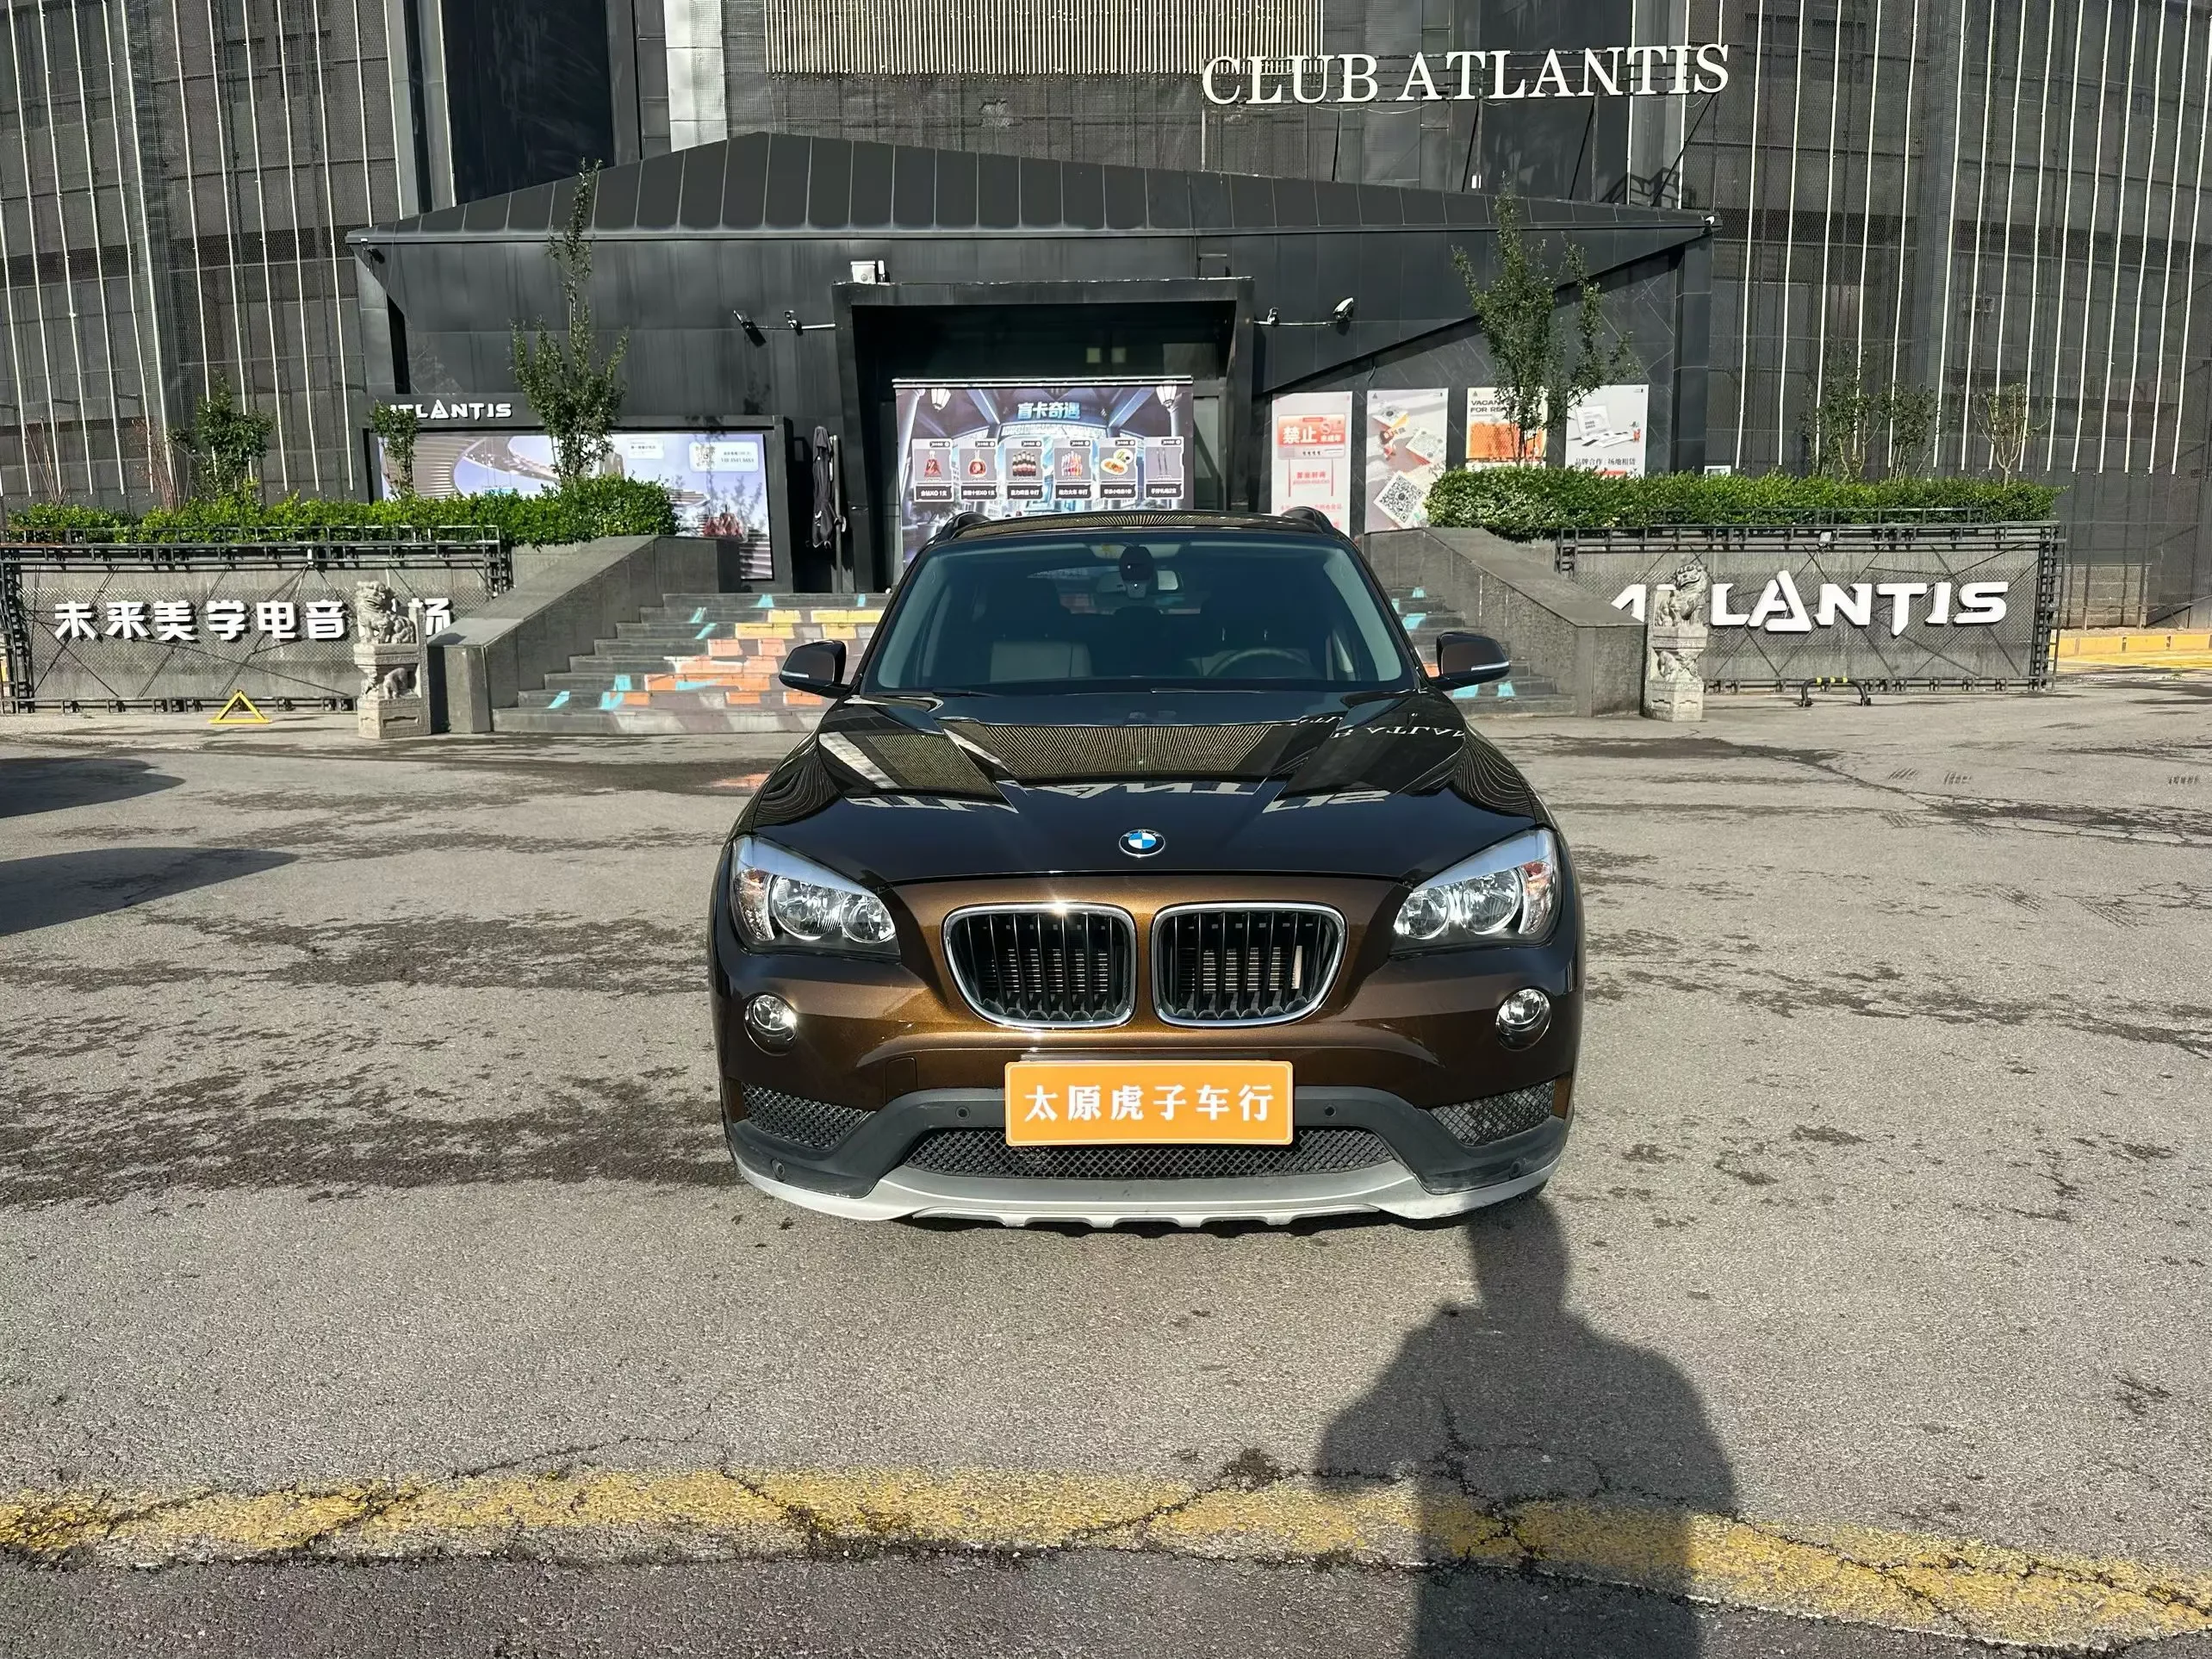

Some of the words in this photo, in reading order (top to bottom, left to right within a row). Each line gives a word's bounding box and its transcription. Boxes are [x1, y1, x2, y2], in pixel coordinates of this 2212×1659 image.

[1202, 53, 1378, 105] CLUB
[1402, 43, 1730, 101] ATLANTIS
[388, 399, 512, 419] TLANTIS
[1017, 401, 1080, 419] 盲卡奇遇
[1283, 426, 1317, 444] 禁止
[54, 596, 450, 641] 未来美学电音场
[1611, 569, 2010, 636] ALANTIS
[1023, 1084, 1275, 1122] 太原虎子车行
